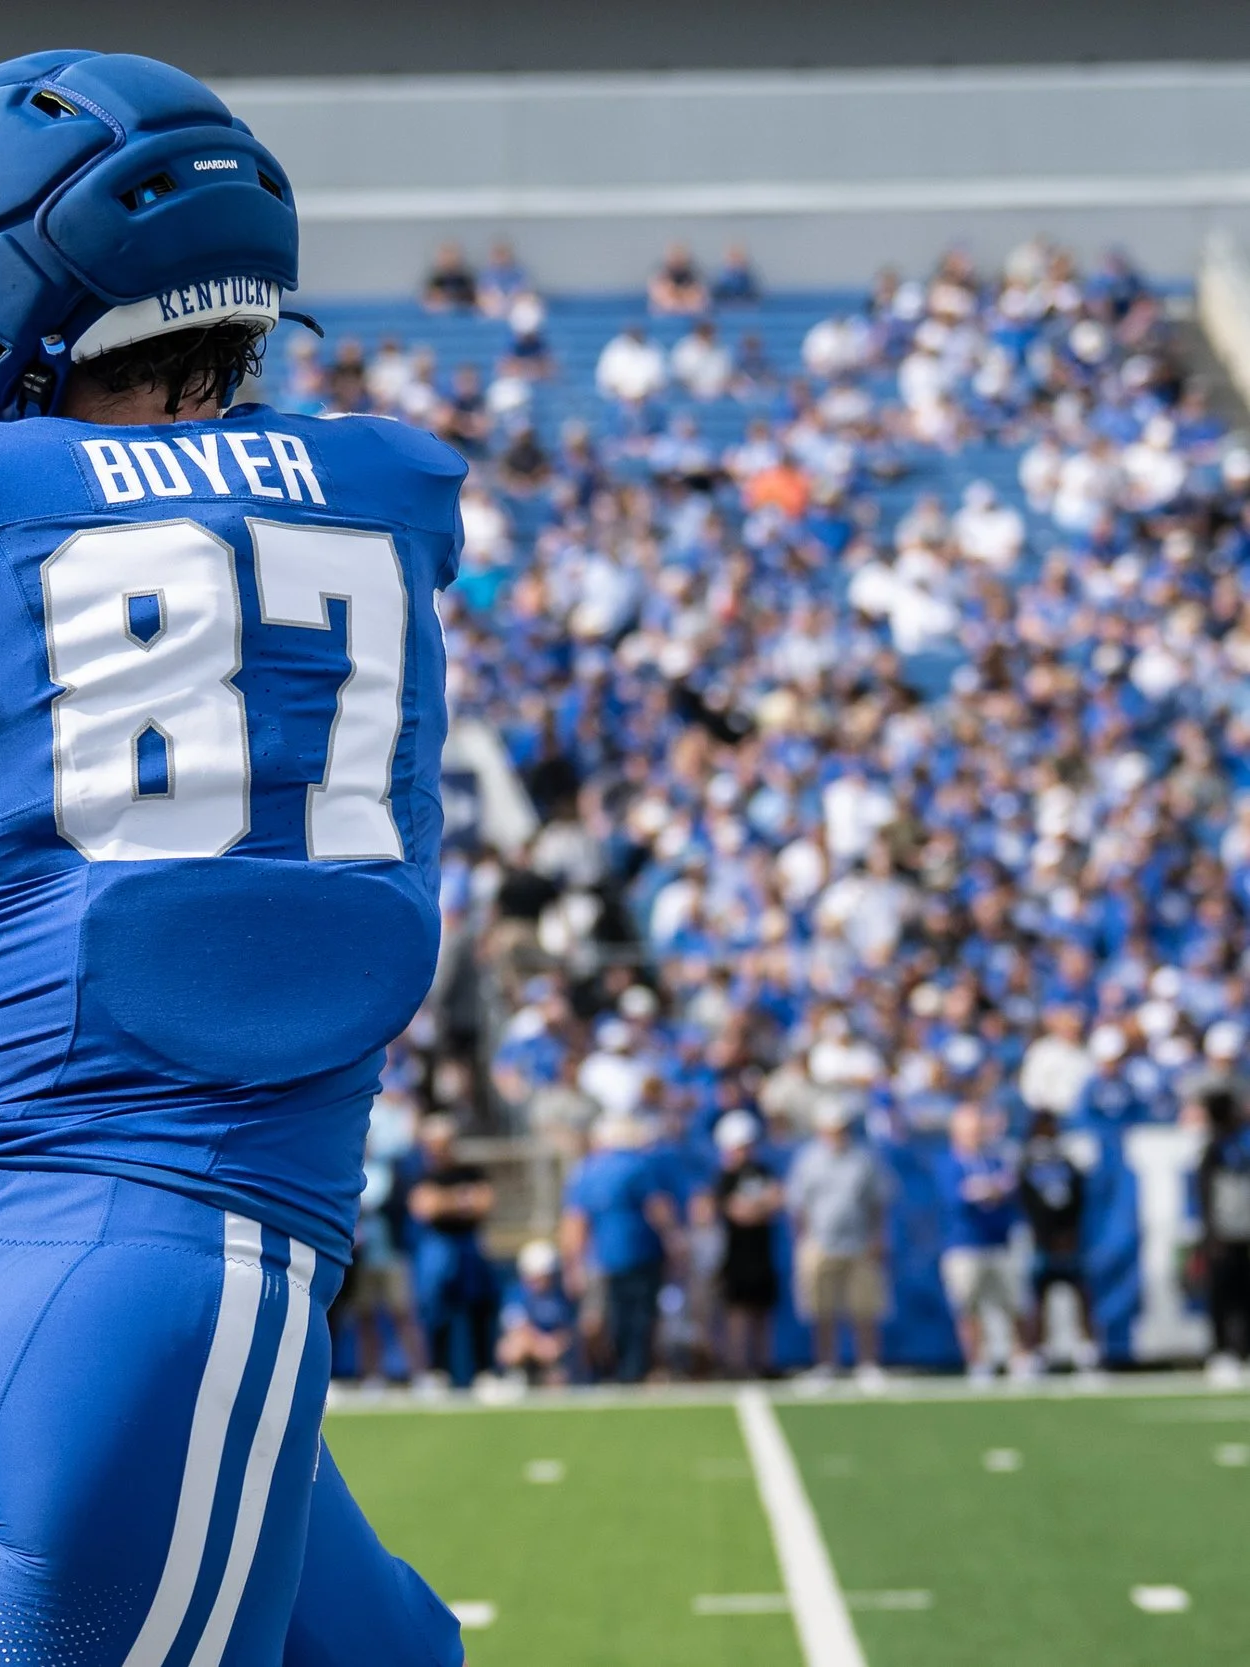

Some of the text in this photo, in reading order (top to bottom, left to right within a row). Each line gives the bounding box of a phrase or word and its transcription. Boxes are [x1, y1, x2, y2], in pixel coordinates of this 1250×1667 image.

[193, 159, 238, 170] GUARDIAN
[156, 276, 272, 322] KENTUCKY
[81, 431, 327, 506] BOYER
[40, 517, 409, 863] 87
